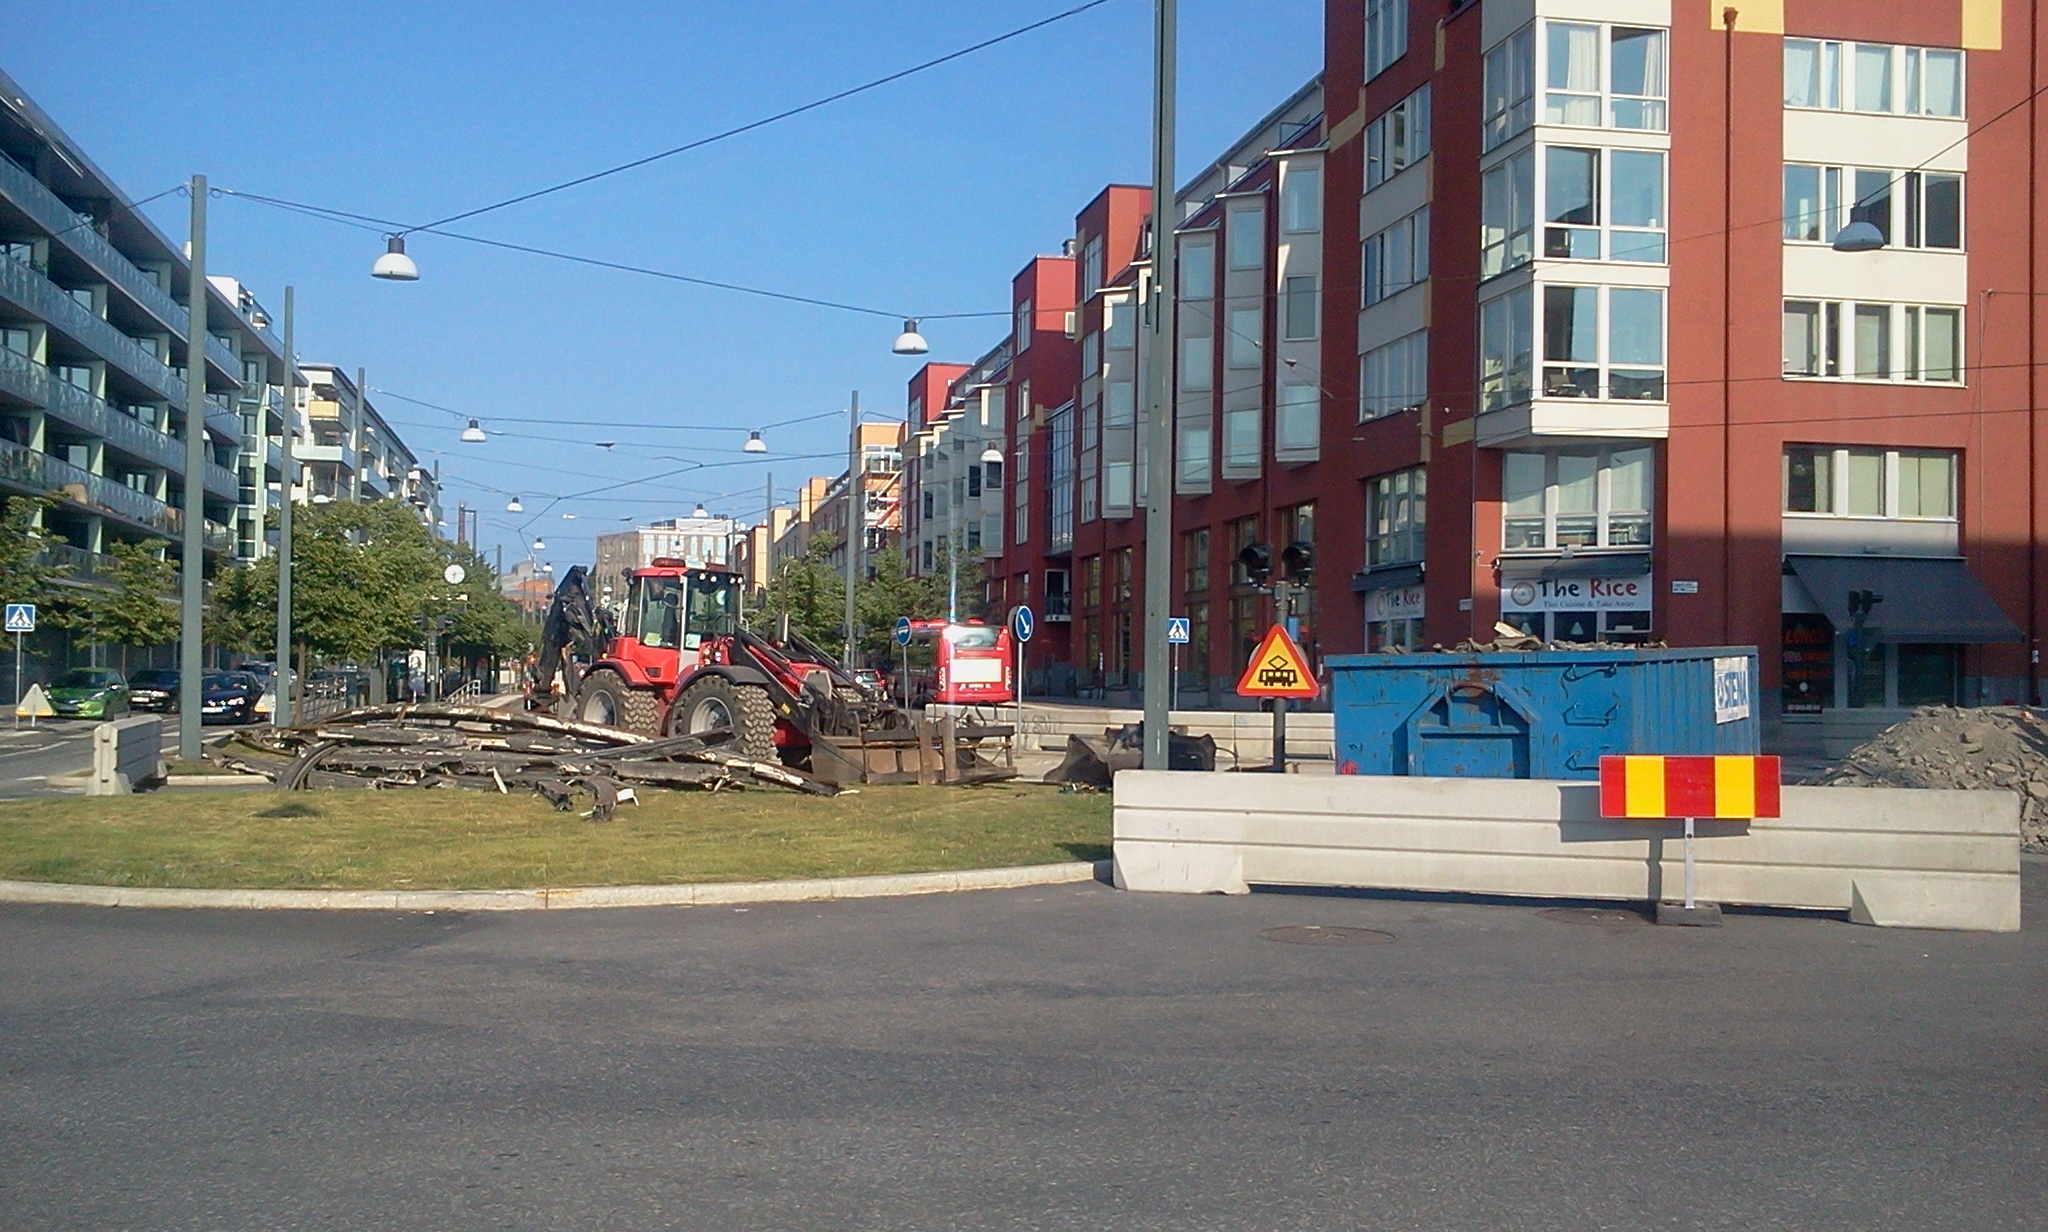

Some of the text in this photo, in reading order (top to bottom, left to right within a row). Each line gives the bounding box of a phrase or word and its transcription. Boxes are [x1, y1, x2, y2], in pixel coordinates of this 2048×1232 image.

[1537, 579, 1638, 598] The Rice
[1386, 591, 1401, 607] The
[1614, 601, 1635, 609] Away
